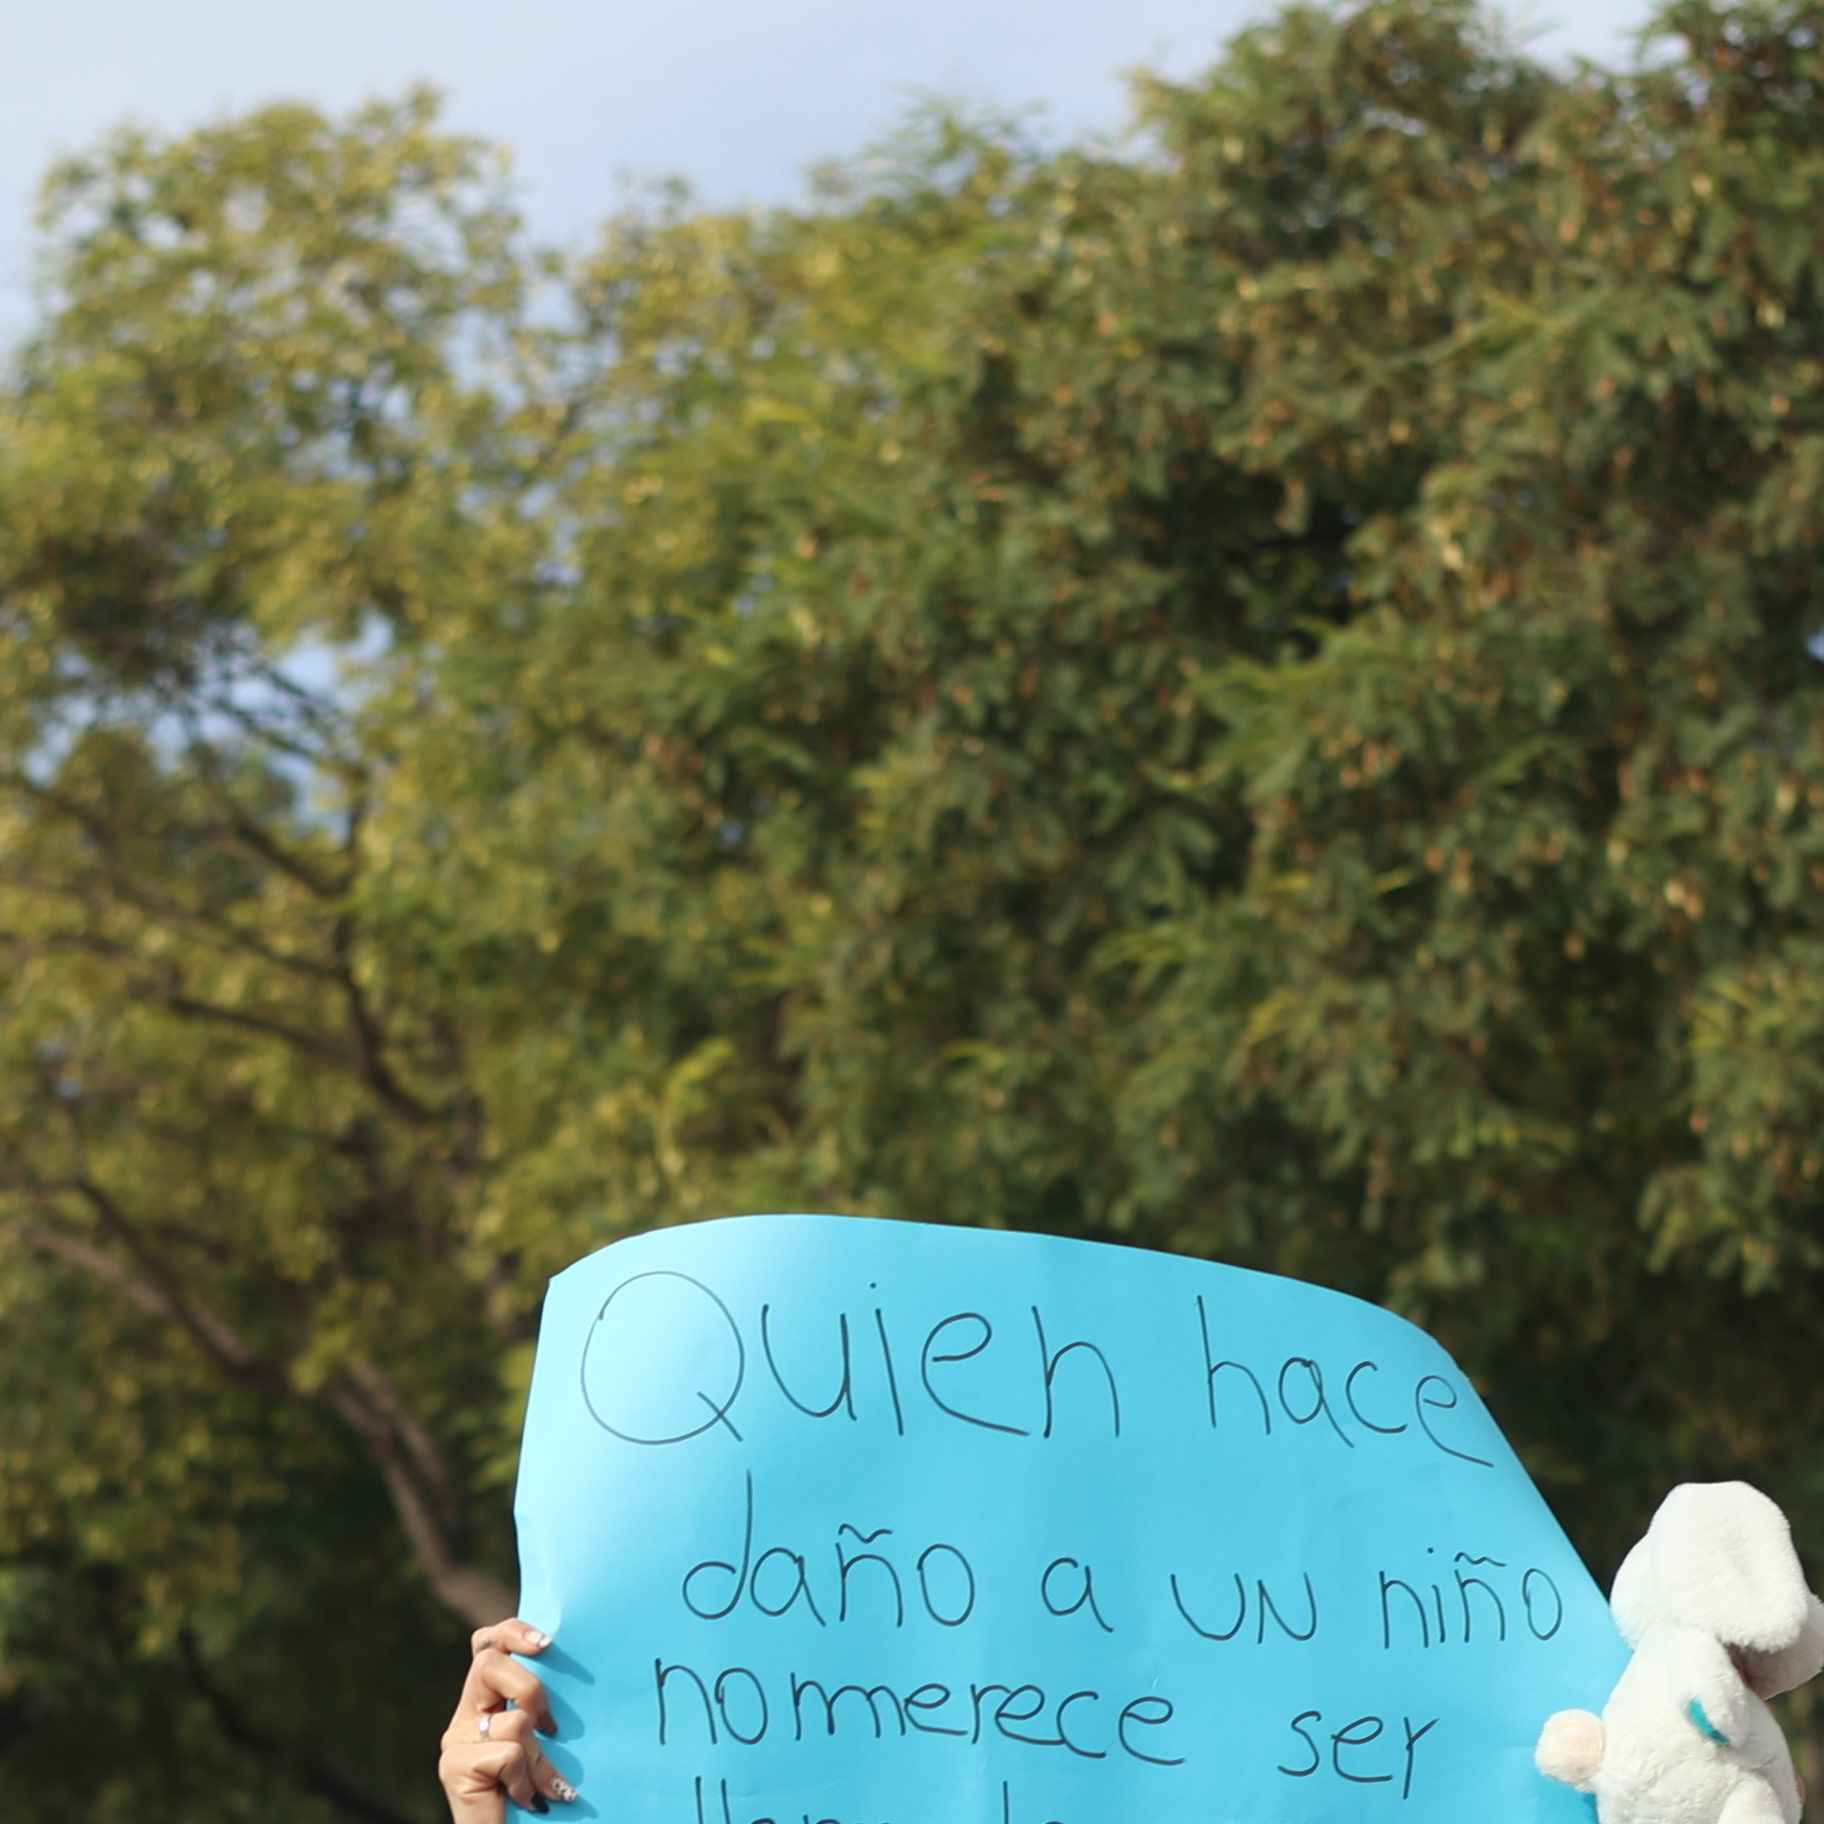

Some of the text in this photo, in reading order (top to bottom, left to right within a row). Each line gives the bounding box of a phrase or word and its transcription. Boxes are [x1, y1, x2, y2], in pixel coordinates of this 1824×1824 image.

[582, 1269, 1494, 1467] Quien hace
[681, 1468, 975, 1628] daño
[1040, 1556, 1115, 1633] a
[1378, 1545, 1564, 1650] niño
[1277, 1709, 1442, 1801] ser
